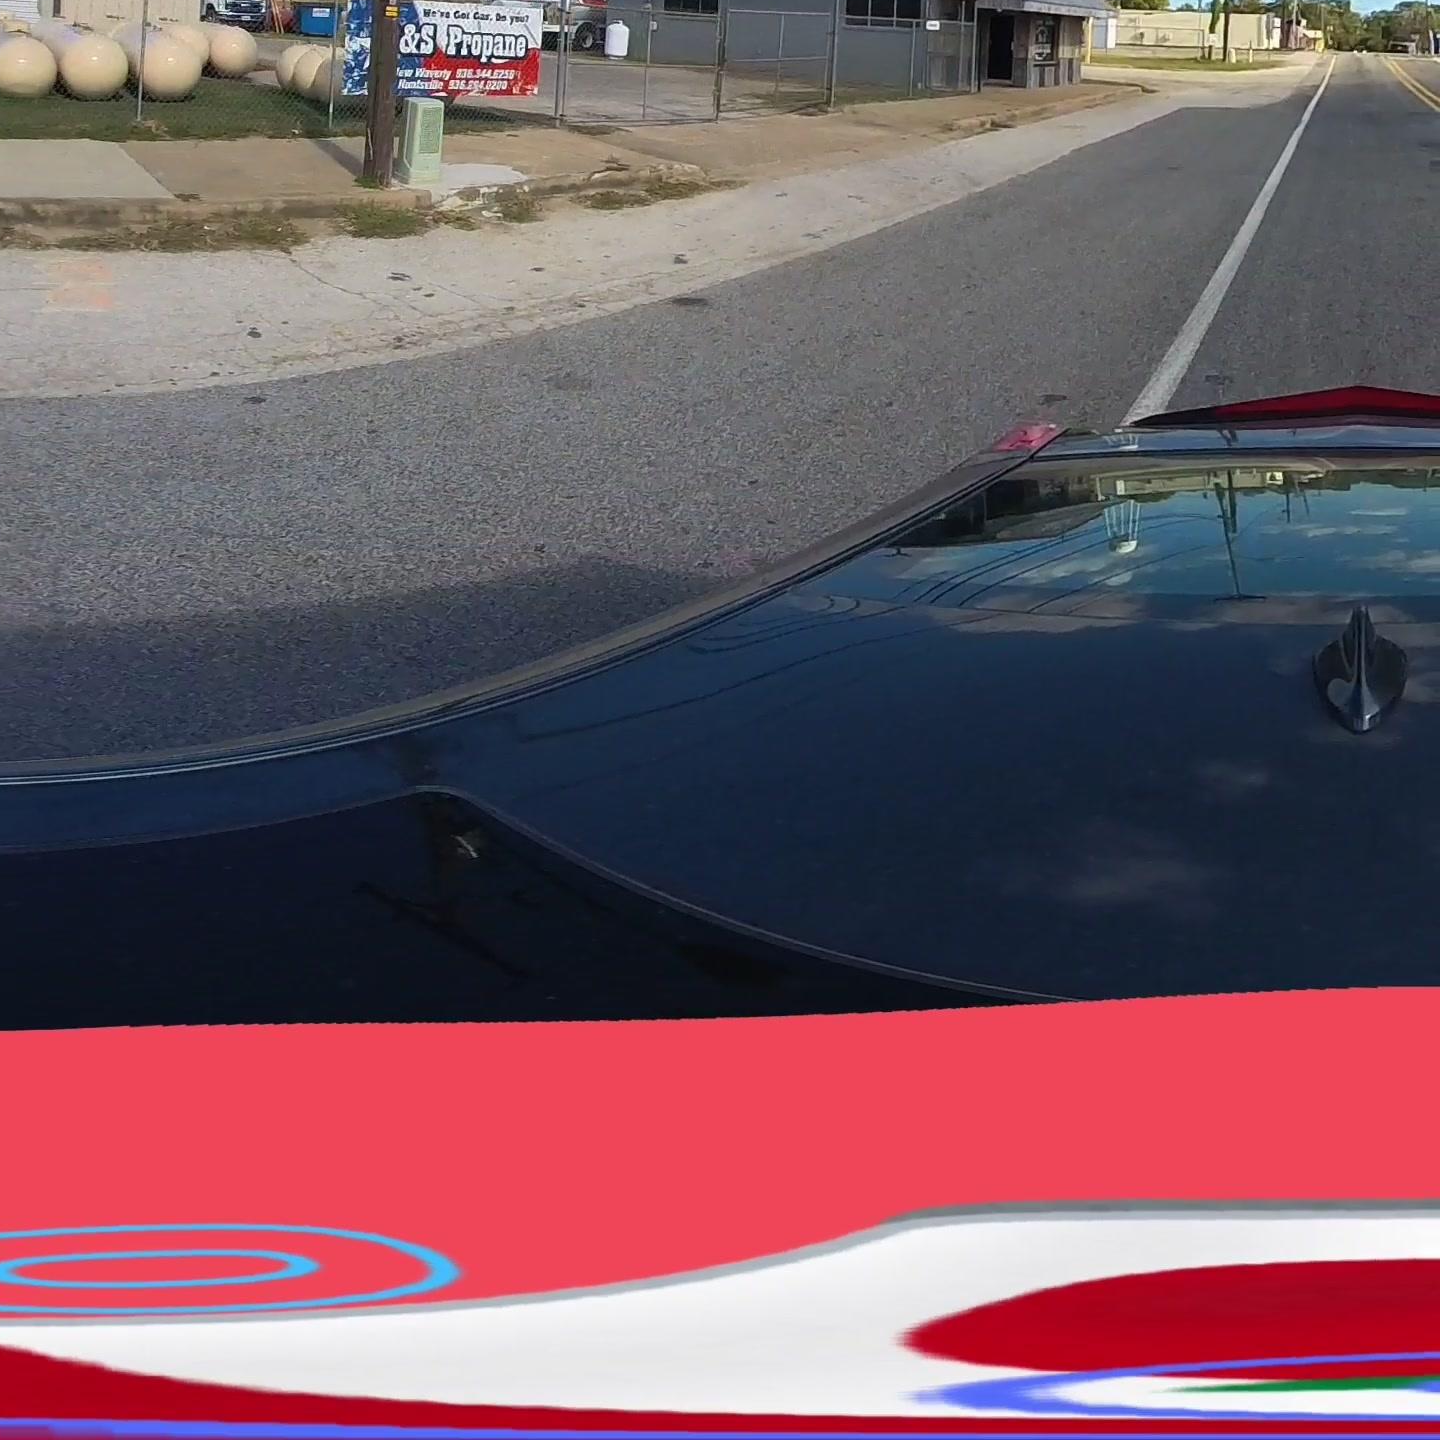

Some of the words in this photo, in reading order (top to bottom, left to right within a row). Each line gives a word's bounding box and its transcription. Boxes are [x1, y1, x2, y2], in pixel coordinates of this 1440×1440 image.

[423, 9, 450, 19] We've
[454, 10, 470, 20] Got
[496, 12, 507, 21] Do
[510, 15, 530, 26] you?
[446, 24, 528, 63] Propane
[415, 68, 452, 80] Waverly
[398, 79, 444, 90] Huntsville
